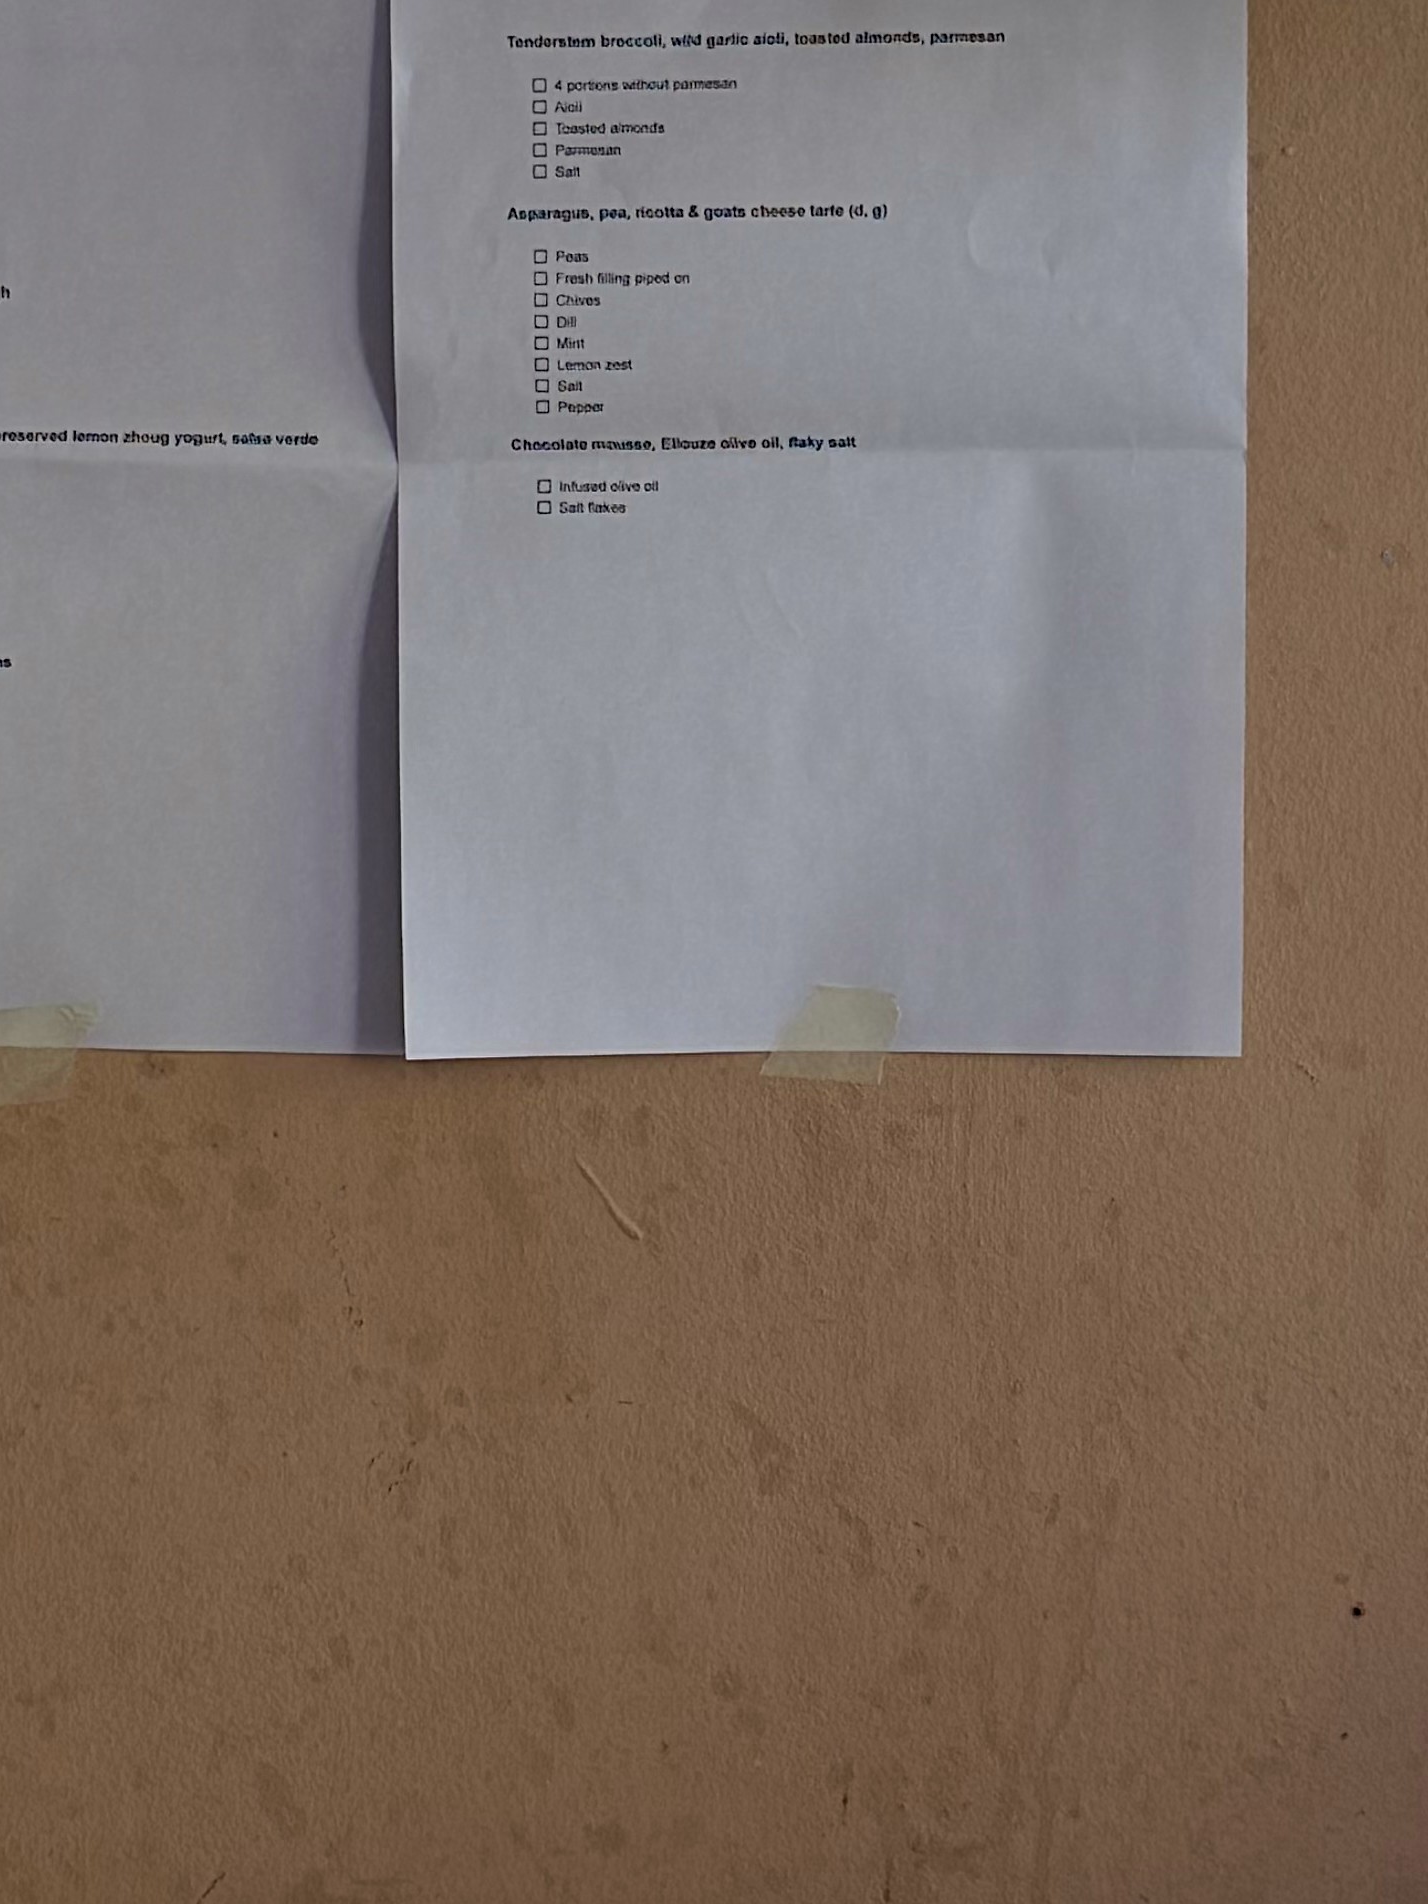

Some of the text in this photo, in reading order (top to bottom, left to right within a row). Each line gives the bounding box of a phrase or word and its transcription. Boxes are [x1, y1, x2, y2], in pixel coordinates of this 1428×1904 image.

[507, 31, 1005, 49] Tenderstem broccoli, wild garlic aioli, toasted almonds, parmesan
[554, 79, 737, 94] 4 portions without parmesan
[554, 101, 582, 113] Aioli
[556, 122, 665, 135] Toasted almonds
[556, 144, 621, 156] Parmesan
[555, 165, 580, 178] Salt
[507, 207, 594, 222] Asparagus,
[599, 208, 631, 222] pea,
[635, 206, 684, 219] ricotta
[688, 204, 700, 218] &
[704, 205, 746, 221] goats
[751, 205, 805, 218] cheese
[556, 250, 589, 263] Peas
[556, 272, 690, 287] Fresh filling piped on
[556, 294, 601, 306] Chives
[557, 316, 577, 328] Dill
[557, 337, 584, 350] Mint
[557, 359, 633, 371] Lemon zest
[558, 380, 583, 392] Salt
[558, 401, 604, 415] Pepper
[72, 430, 118, 443] lemon
[276, 432, 319, 446] verde
[511, 438, 587, 451] Chocolate
[720, 436, 756, 449] olive
[761, 436, 784, 450] oil,
[789, 435, 824, 451] flaky
[828, 436, 857, 448] salt
[559, 480, 659, 492] Infused olive oil
[559, 501, 584, 514] Salt
